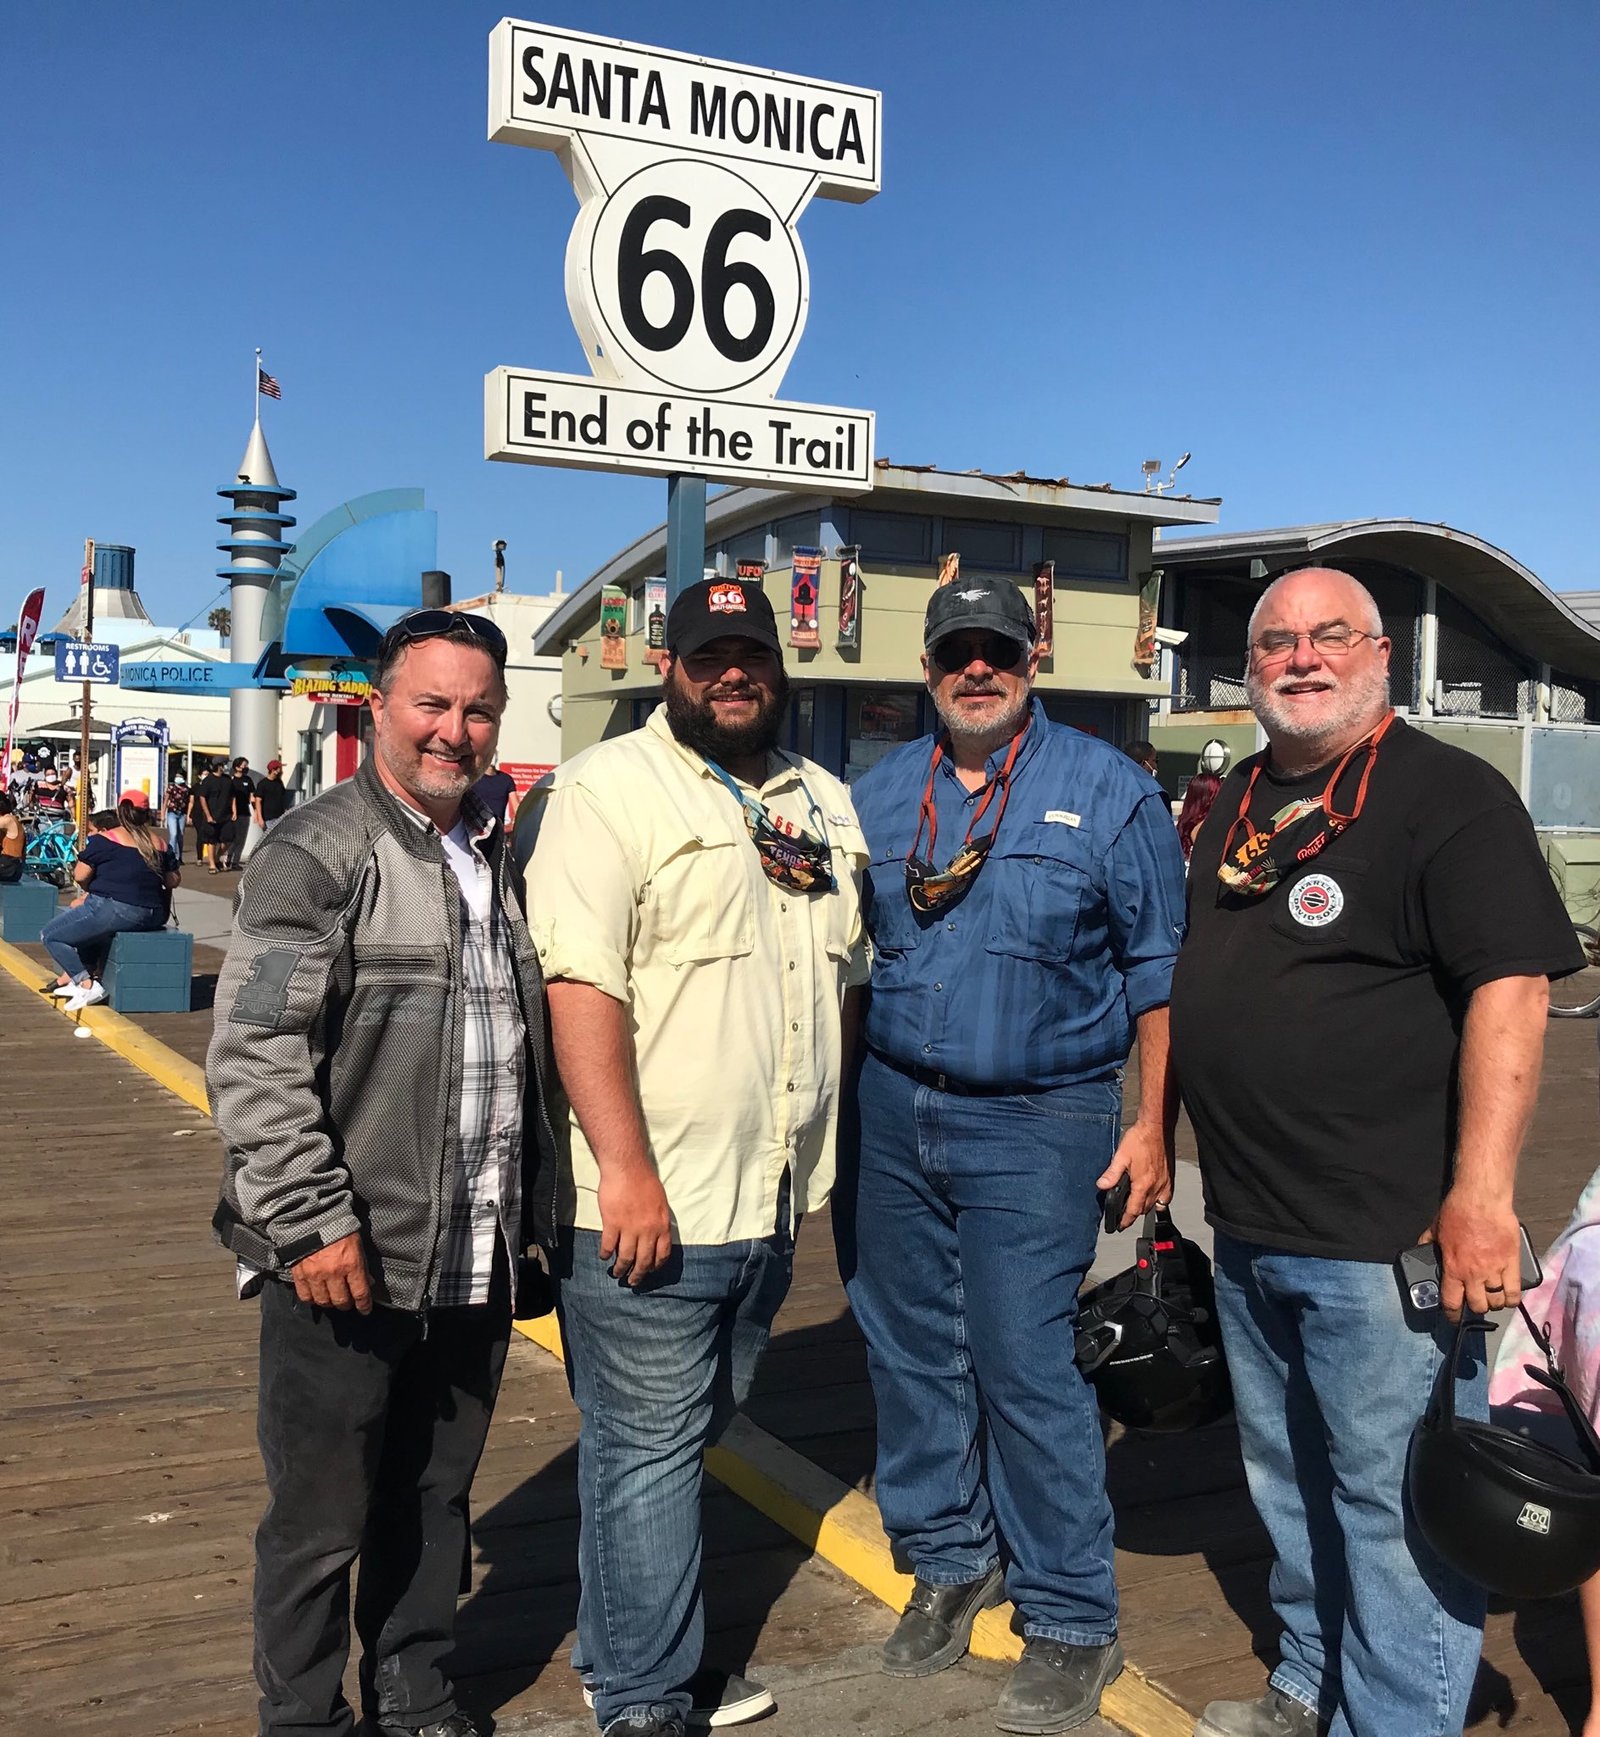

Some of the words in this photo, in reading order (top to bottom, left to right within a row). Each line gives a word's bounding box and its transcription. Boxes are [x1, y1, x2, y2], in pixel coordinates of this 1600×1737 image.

[522, 46, 671, 130] SANTA
[690, 80, 866, 165] MONICA
[617, 194, 775, 363] 66
[523, 391, 608, 446] End
[626, 402, 672, 452] of
[686, 407, 753, 461] the
[768, 420, 856, 471] Trail
[738, 565, 762, 577] UFO
[711, 591, 743, 604] 66
[65, 642, 110, 652] RESTROOMS
[125, 667, 157, 681] MONICA
[161, 667, 213, 681] POLICE
[293, 679, 337, 697] BLAZING
[119, 724, 137, 735] SANTA
[138, 724, 161, 735] MONICA
[774, 815, 794, 836] 66
[1245, 836, 1270, 860] 66
[1298, 880, 1336, 899] HARLEY
[1294, 897, 1336, 921] DAVIDSON
[1523, 1509, 1548, 1525] DOT
